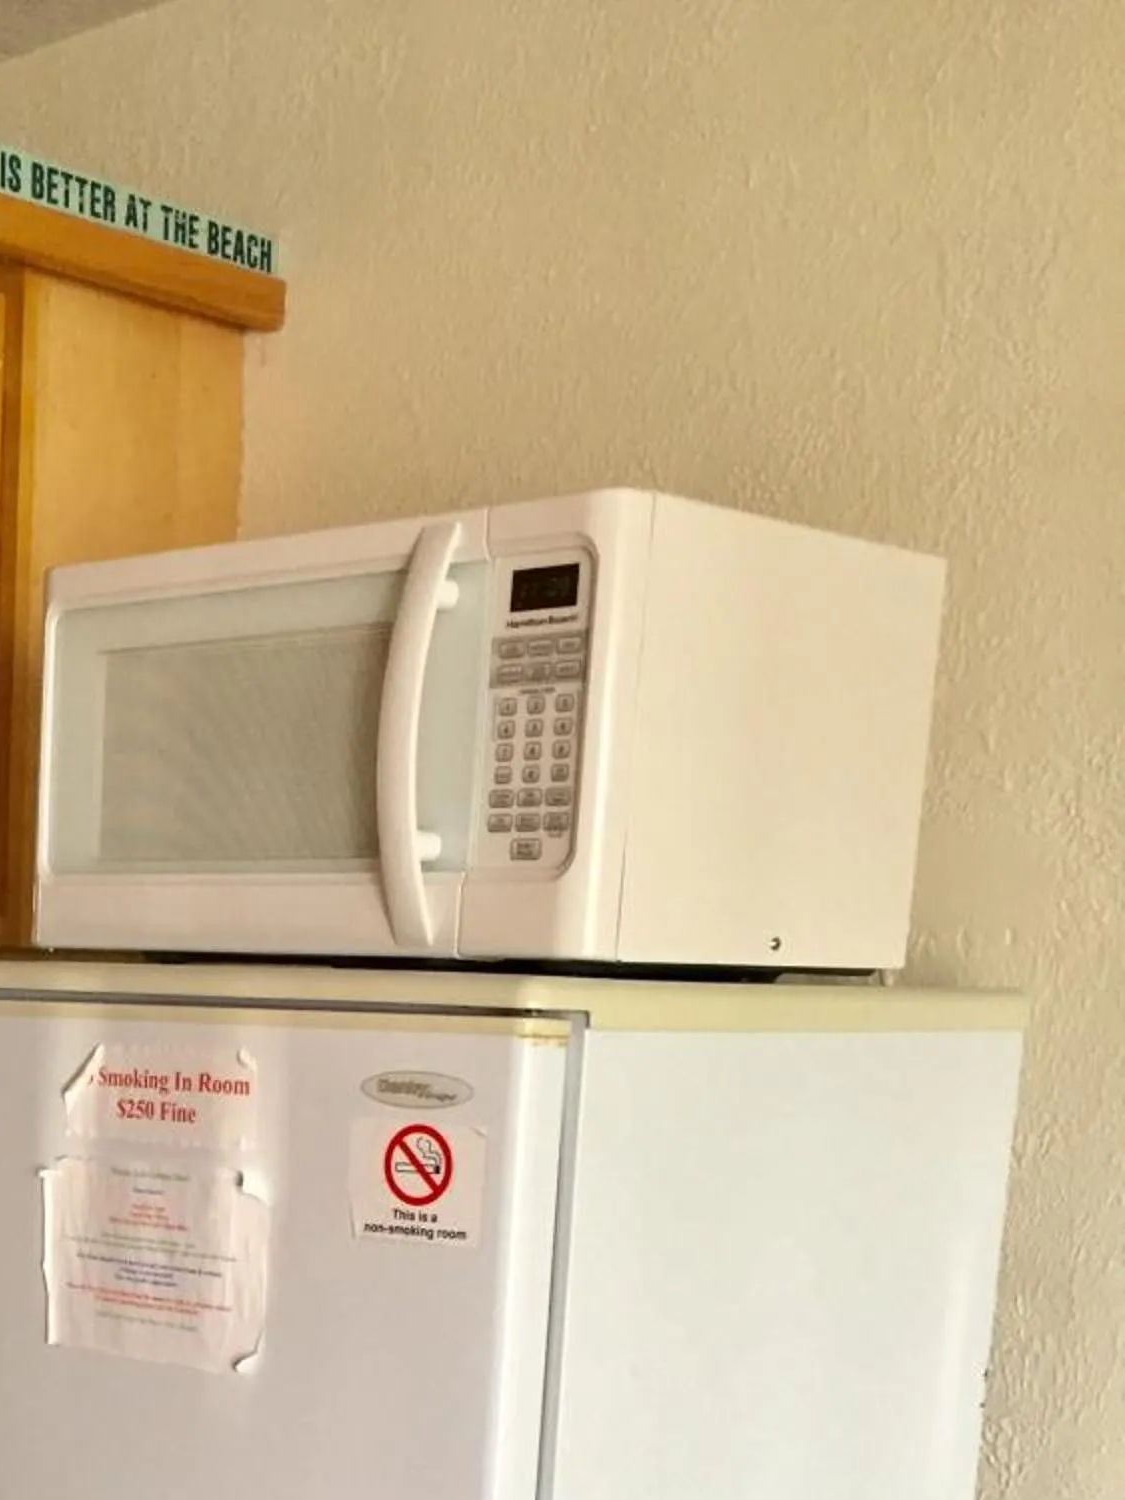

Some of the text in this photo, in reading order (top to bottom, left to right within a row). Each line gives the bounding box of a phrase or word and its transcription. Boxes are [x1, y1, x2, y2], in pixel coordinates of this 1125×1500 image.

[0, 151, 22, 193] IS
[31, 161, 116, 223] BETTER
[125, 194, 152, 233] AT
[161, 204, 200, 249] THE
[207, 220, 272, 274] BEACH
[97, 1066, 171, 1096] Smoking
[174, 1071, 193, 1092] In
[198, 1073, 251, 1096] Room
[116, 1098, 198, 1125] $250 Fine
[392, 1208, 438, 1223] This is a
[363, 1223, 467, 1240] non-smoking room
